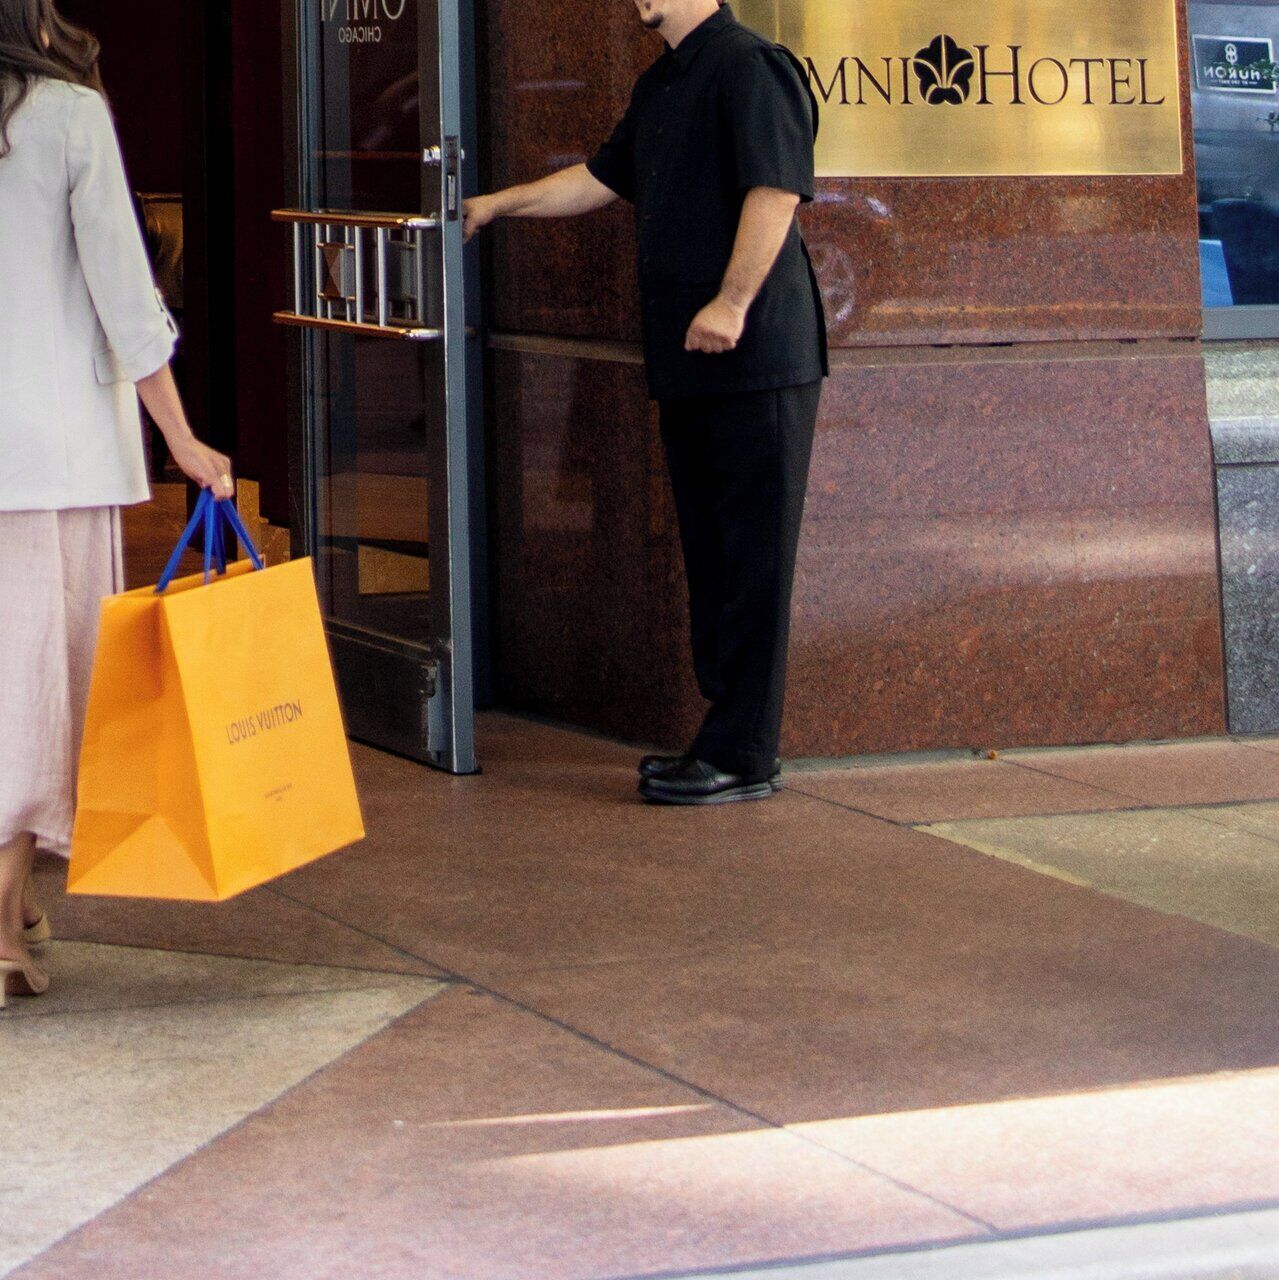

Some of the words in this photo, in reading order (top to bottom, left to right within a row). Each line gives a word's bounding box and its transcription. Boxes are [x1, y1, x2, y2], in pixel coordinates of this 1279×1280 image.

[803, 55, 915, 106] MNI
[975, 44, 1166, 106] HOTEL
[227, 716, 256, 744] LOUIS
[257, 700, 303, 731] VUITTON
